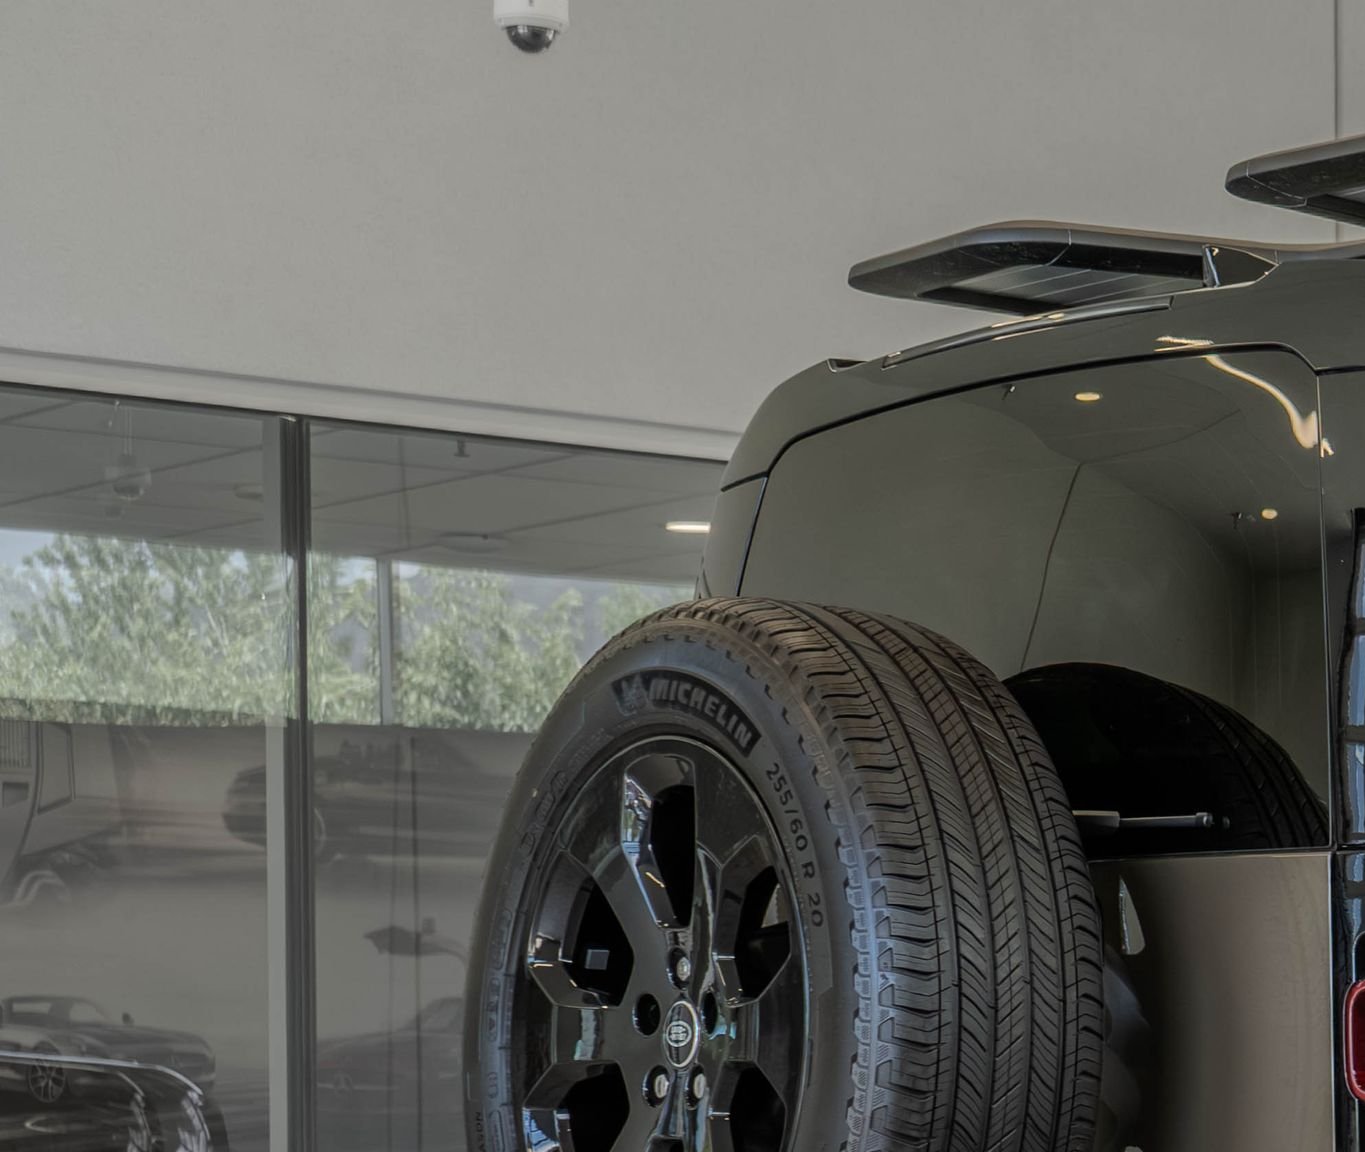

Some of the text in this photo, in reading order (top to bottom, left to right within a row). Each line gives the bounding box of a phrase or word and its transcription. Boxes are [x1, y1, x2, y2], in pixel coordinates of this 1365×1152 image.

[650, 678, 753, 749] MICHELIN
[766, 762, 824, 928] 255/60 R 20
